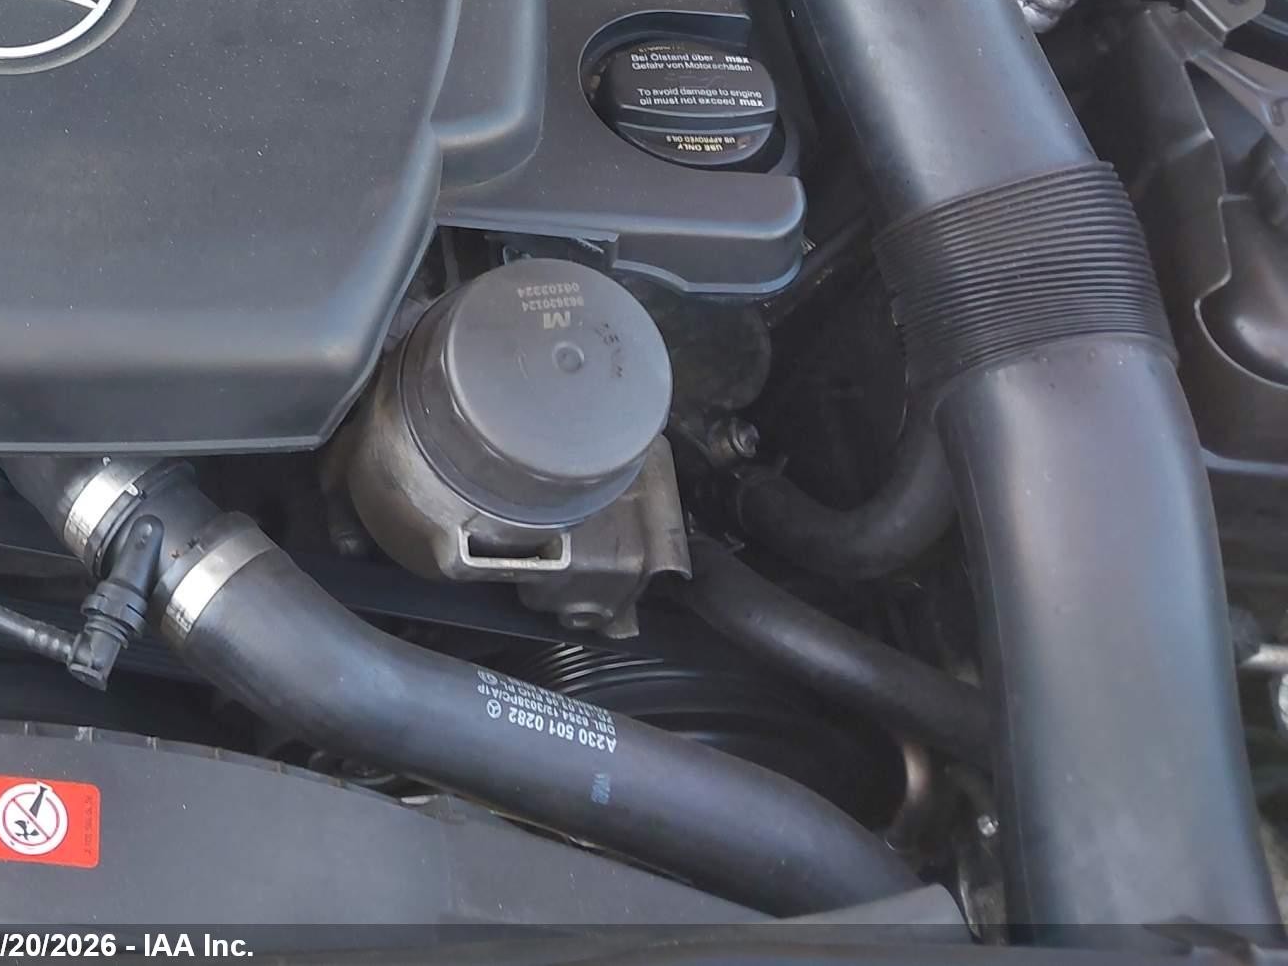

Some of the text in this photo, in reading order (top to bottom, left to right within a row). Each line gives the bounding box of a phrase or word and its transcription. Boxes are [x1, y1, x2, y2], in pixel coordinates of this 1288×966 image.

[631, 53, 648, 62] Bei
[725, 55, 750, 64] max
[631, 62, 664, 70] Gefahr
[637, 87, 762, 99] To avoid damage to engine
[639, 97, 764, 107] oil must not exceed max
[677, 143, 723, 152] USE ONLY
[508, 706, 544, 731] 0282
[549, 719, 574, 740] 501
[579, 729, 617, 753] A230
